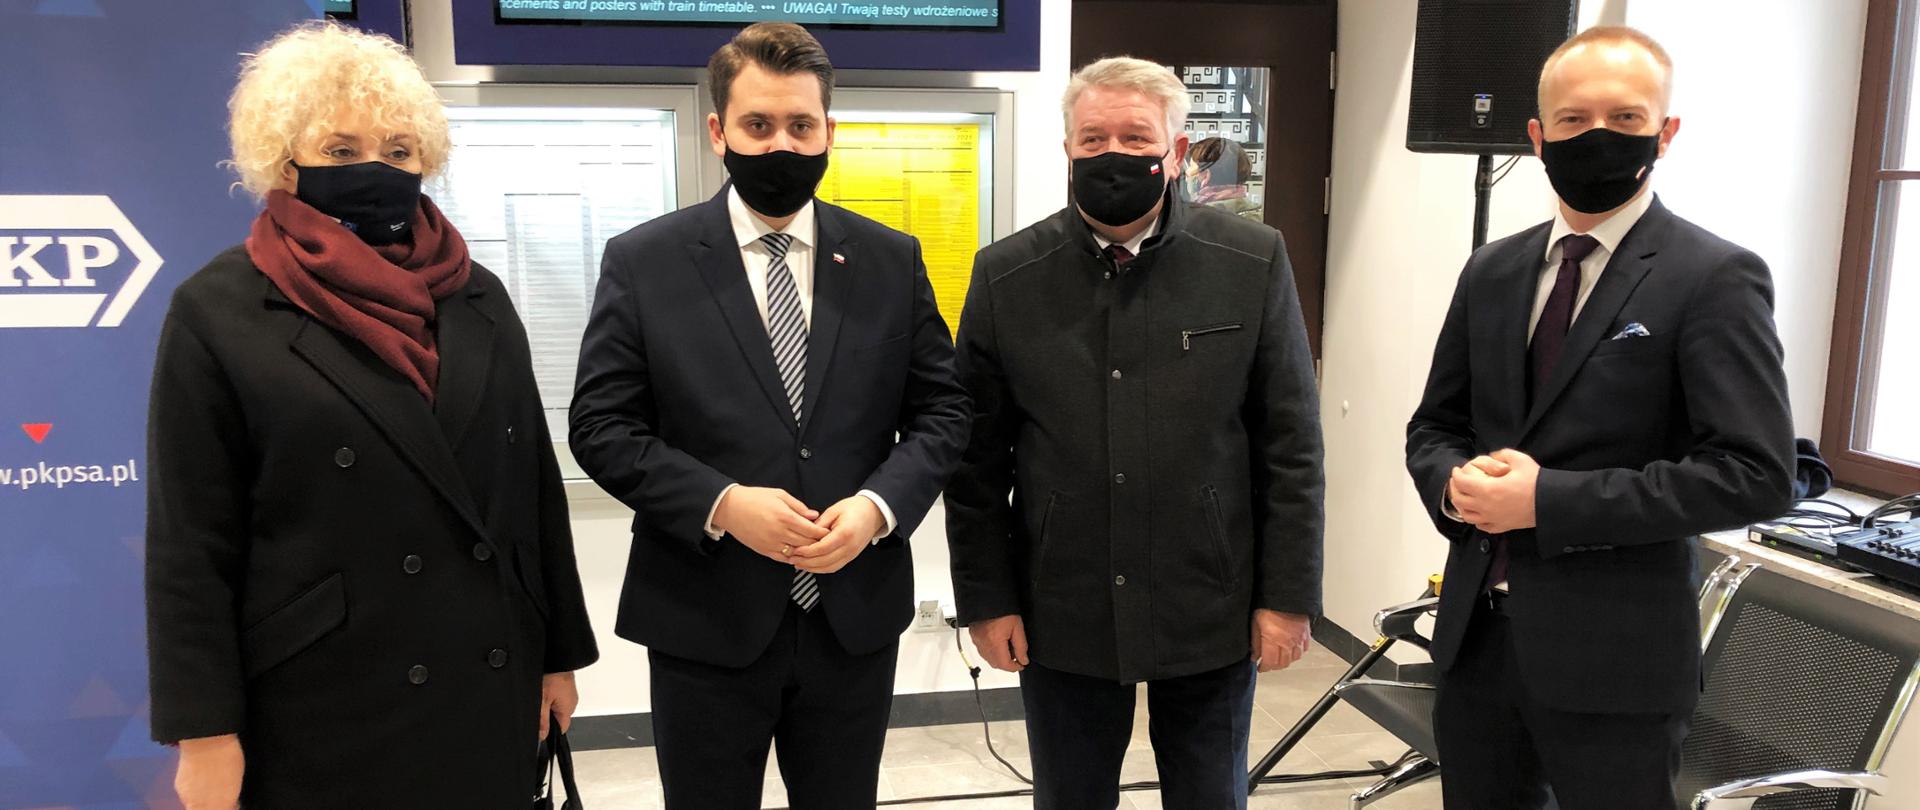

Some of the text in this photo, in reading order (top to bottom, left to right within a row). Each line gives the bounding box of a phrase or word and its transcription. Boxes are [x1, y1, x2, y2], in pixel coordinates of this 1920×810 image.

[563, 0, 586, 10] and
[590, 0, 636, 12] posters
[640, 0, 664, 11] with
[668, 1, 695, 12] train
[699, 1, 757, 13] timetable.
[783, 3, 837, 14] UWAGA!
[841, 3, 879, 17] Trwają
[882, 5, 910, 17] testy
[913, 5, 988, 17] wdrożeniowe
